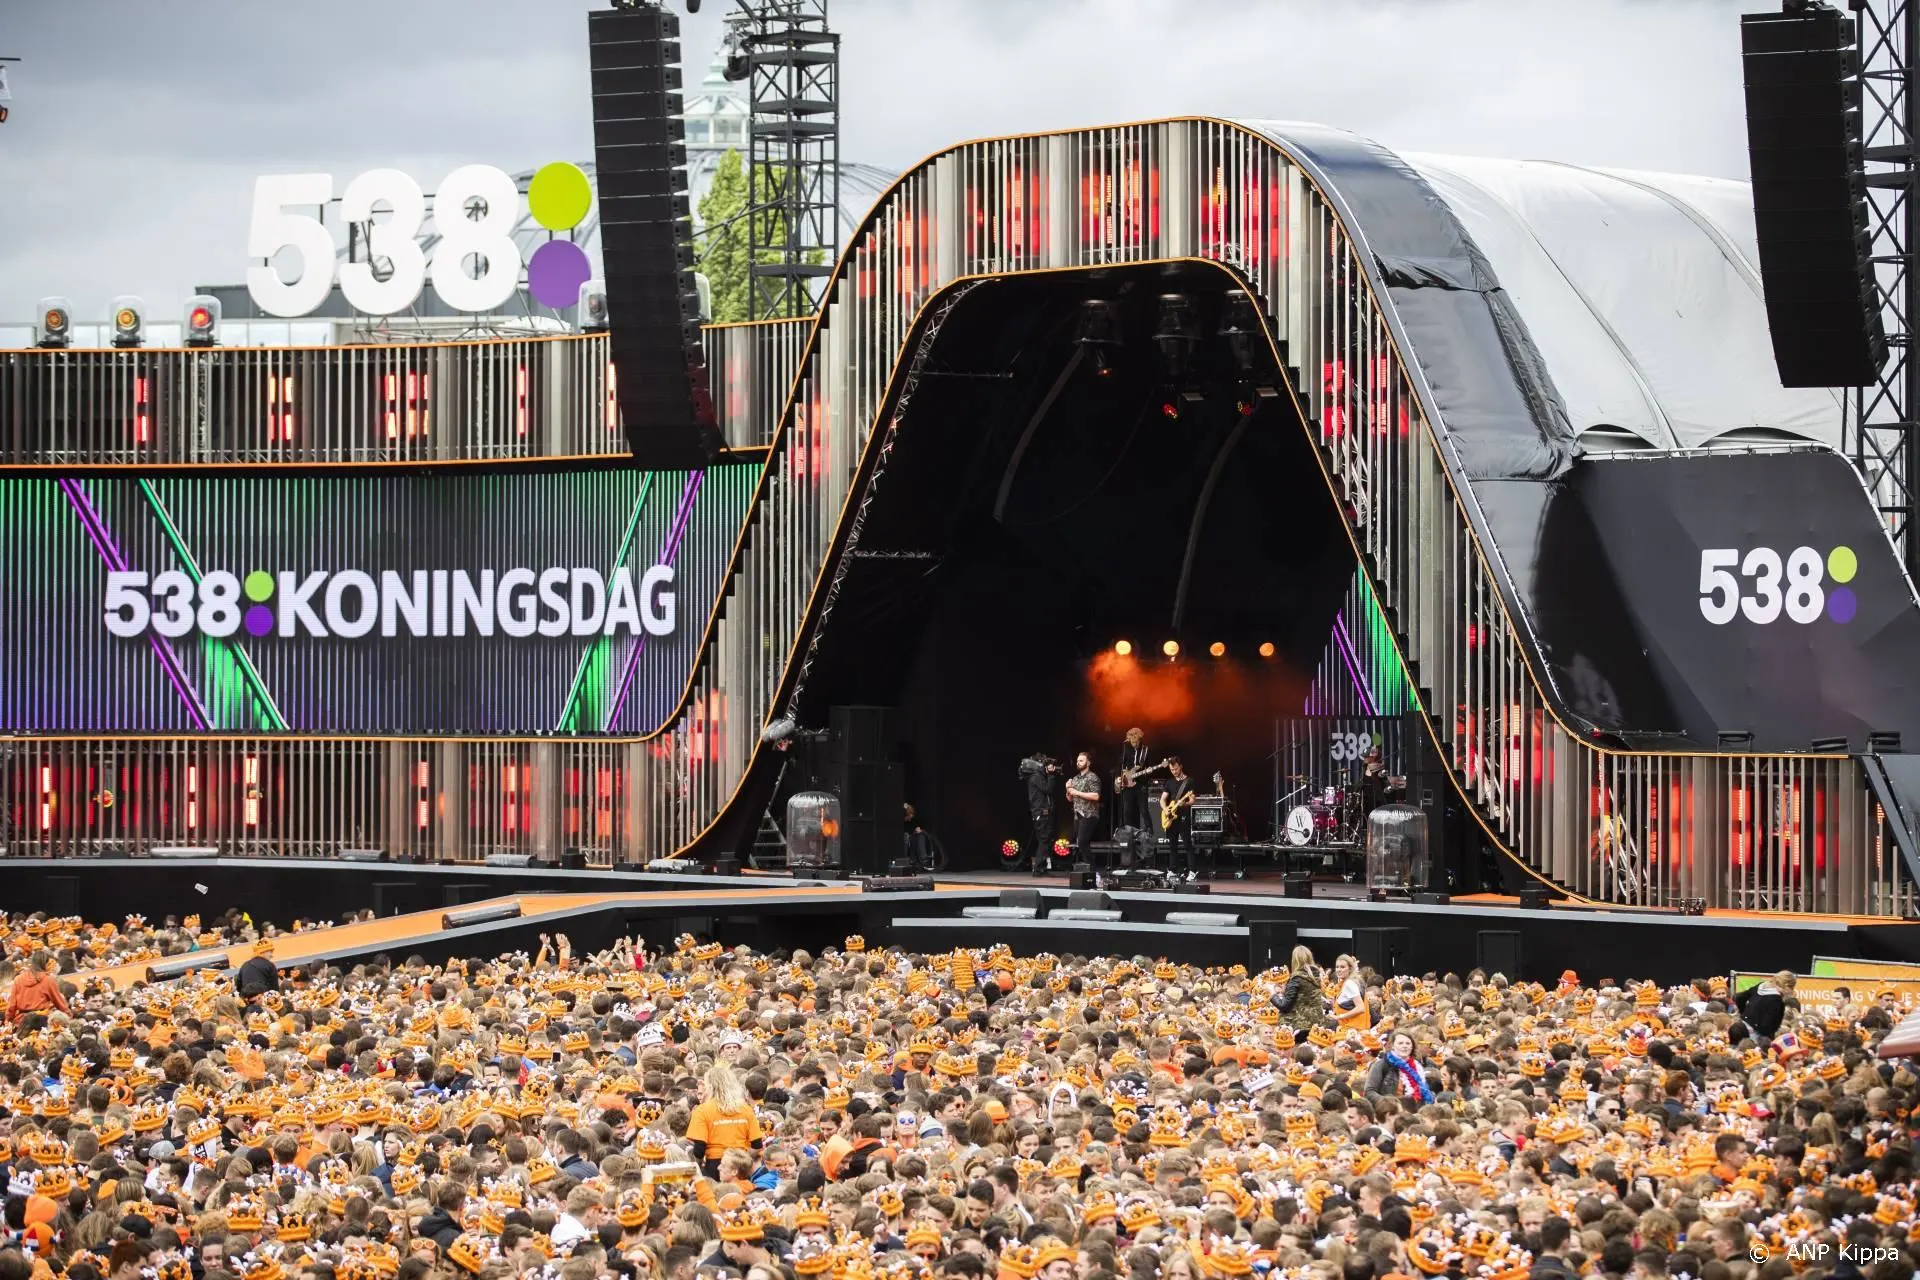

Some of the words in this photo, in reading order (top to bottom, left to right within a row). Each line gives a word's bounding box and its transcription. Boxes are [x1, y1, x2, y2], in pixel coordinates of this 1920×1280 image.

[247, 164, 519, 317] 538
[278, 564, 675, 638] KONINGSDAG
[1699, 546, 1825, 625] 538
